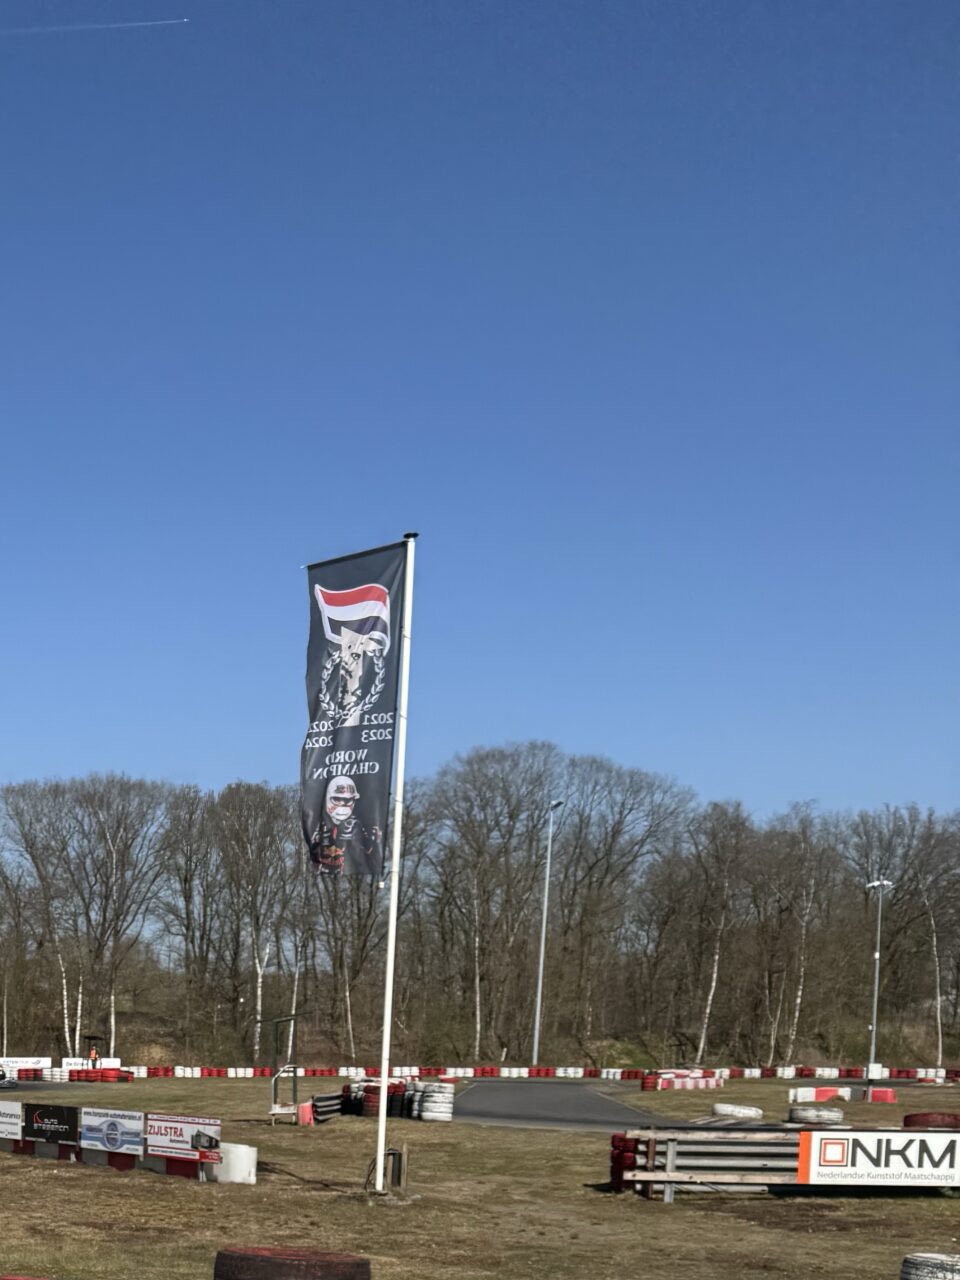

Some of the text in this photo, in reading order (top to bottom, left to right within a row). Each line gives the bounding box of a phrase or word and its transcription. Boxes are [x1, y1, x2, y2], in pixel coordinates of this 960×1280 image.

[148, 1124, 184, 1138] ZIJLSTRA
[850, 1138, 957, 1169] NKM
[817, 1171, 955, 1182] Nederlandse Kunststof Maatschappij
